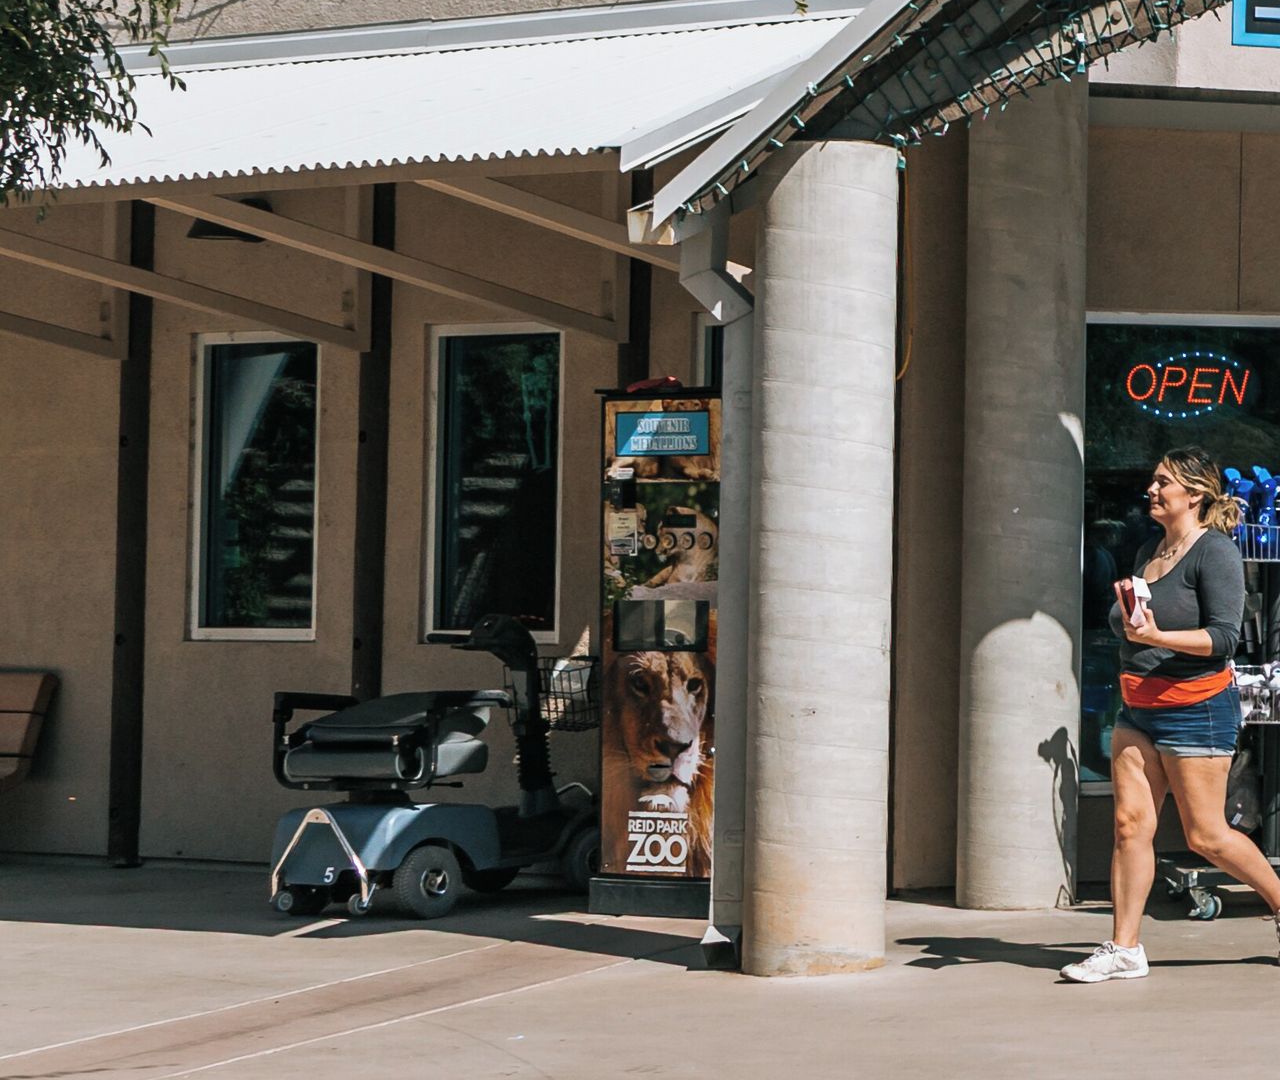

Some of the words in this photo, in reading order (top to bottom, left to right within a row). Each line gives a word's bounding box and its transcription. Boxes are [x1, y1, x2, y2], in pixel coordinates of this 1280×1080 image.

[1126, 364, 1250, 404] OPEN
[637, 418, 690, 433] SOUVENIR
[630, 435, 698, 451] MEDALLIONS
[628, 819, 655, 833] REID
[656, 820, 689, 834] PARK
[626, 833, 688, 865] ZOO
[324, 866, 335, 883] 5
